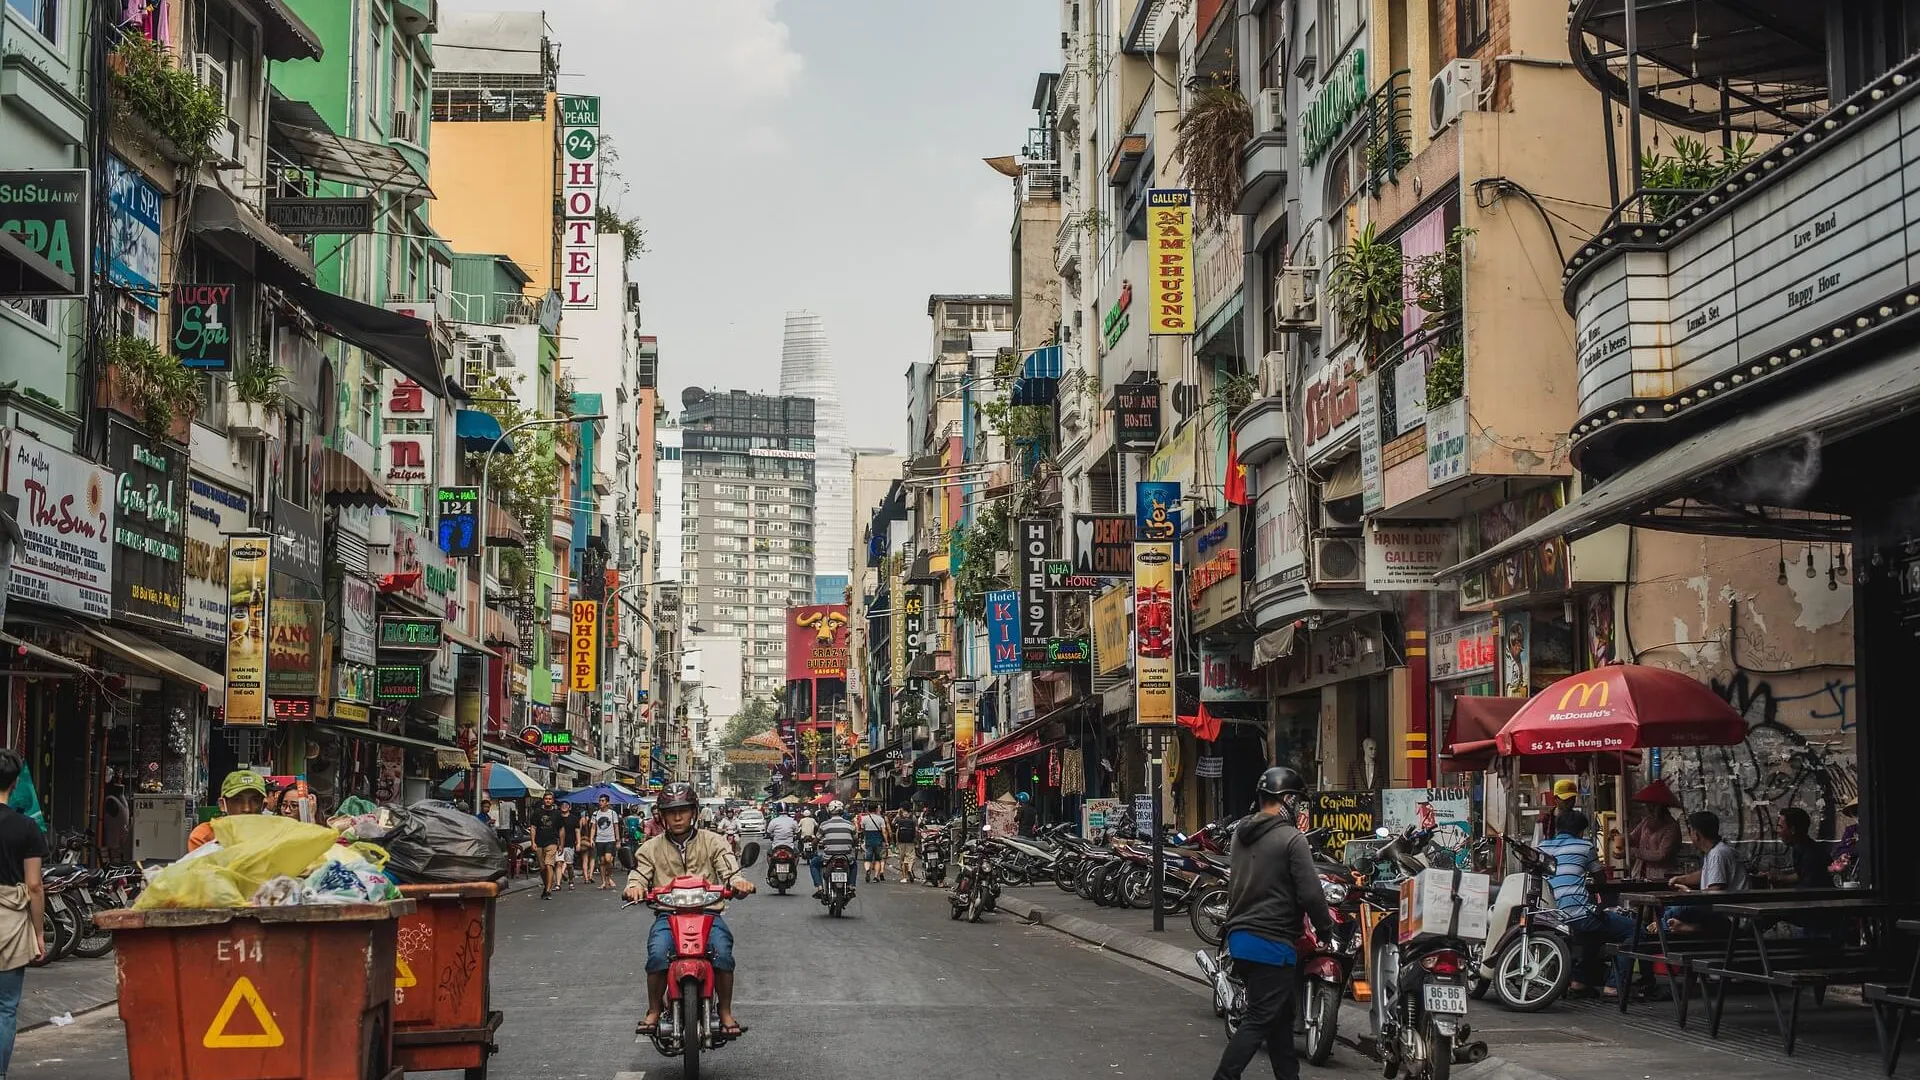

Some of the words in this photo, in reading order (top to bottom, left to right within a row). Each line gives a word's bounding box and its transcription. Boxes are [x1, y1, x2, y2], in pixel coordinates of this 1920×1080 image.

[573, 99, 589, 111] VN
[564, 111, 598, 124] PEARL
[568, 136, 592, 152] 94
[0, 184, 48, 203] SuSu
[1151, 193, 1188, 204] GALLERY
[140, 184, 160, 224] SPA
[568, 163, 594, 304] HOTEL
[1793, 226, 1810, 249] Live
[1814, 212, 1837, 237] Band
[2, 219, 75, 275] PA
[176, 287, 231, 305] LUCKY
[1787, 285, 1815, 308] Happy
[1817, 272, 1841, 292] Hour
[205, 303, 223, 330] 1
[1686, 312, 1706, 333] Lunch
[1708, 305, 1720, 322] Set
[175, 305, 230, 359] Spa
[1140, 395, 1157, 408] ANH
[387, 468, 426, 482] Saigon
[442, 501, 472, 515] 124
[98, 512, 107, 543] 2
[1028, 525, 1044, 603] HOTEL
[1384, 551, 1443, 563] GALLERY
[1048, 564, 1069, 574] NHA
[906, 599, 921, 614] 65
[989, 592, 1016, 603] Hotel
[573, 602, 594, 623] 96
[1029, 605, 1044, 636] 97
[383, 622, 439, 643] HOTEL
[994, 603, 1016, 662] KIM
[575, 625, 590, 689] HOTEL
[812, 648, 846, 657] CRAZY
[895, 635, 904, 679] SAIGON
[907, 619, 919, 690] HOTL
[1057, 652, 1081, 660] MASSAGE
[383, 672, 415, 683] SPA
[1549, 710, 1611, 721] McDonald's
[1531, 741, 1543, 751] Số
[1544, 741, 1554, 751] 2,
[1320, 795, 1357, 811] Capital
[1313, 813, 1372, 832] LAUNDRY
[217, 939, 264, 963] E14
[1430, 986, 1460, 999] 86-B6
[1428, 998, 1465, 1012] 189.04
